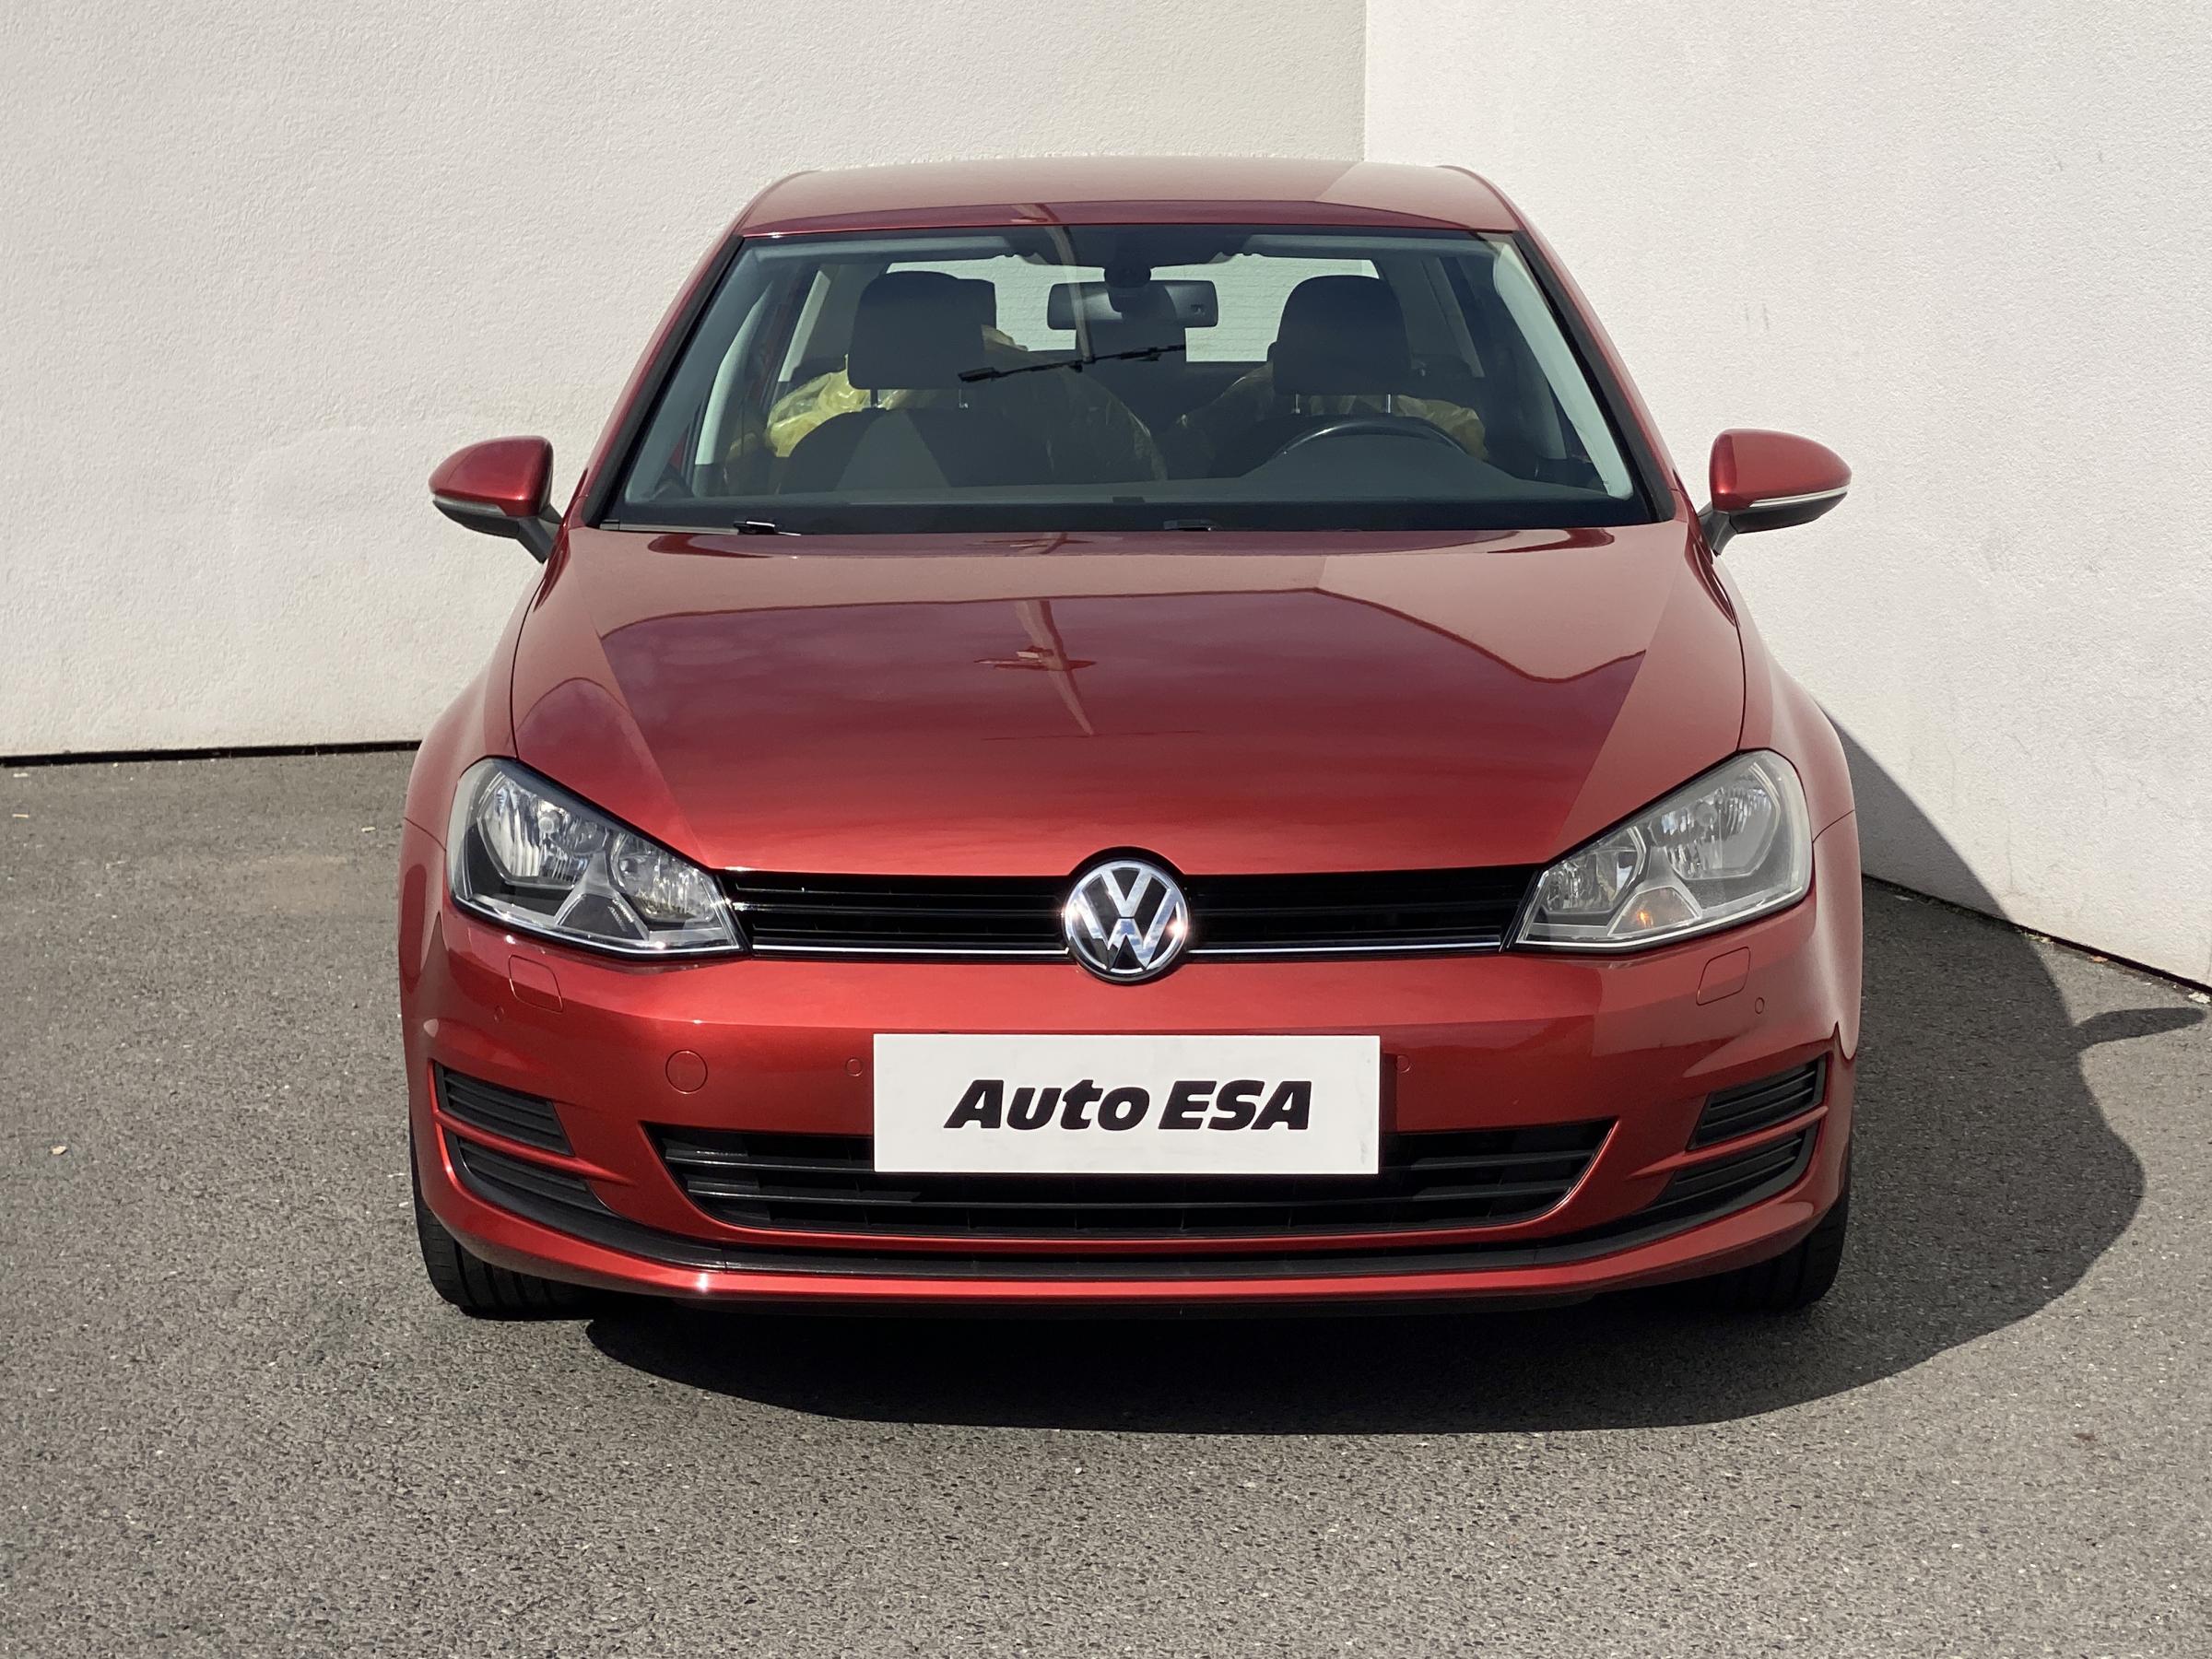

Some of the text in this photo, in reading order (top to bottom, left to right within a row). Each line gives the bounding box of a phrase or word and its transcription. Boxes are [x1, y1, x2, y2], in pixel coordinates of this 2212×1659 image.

[1069, 863, 1183, 974] VW
[943, 1079, 1312, 1132] Auto ESA
